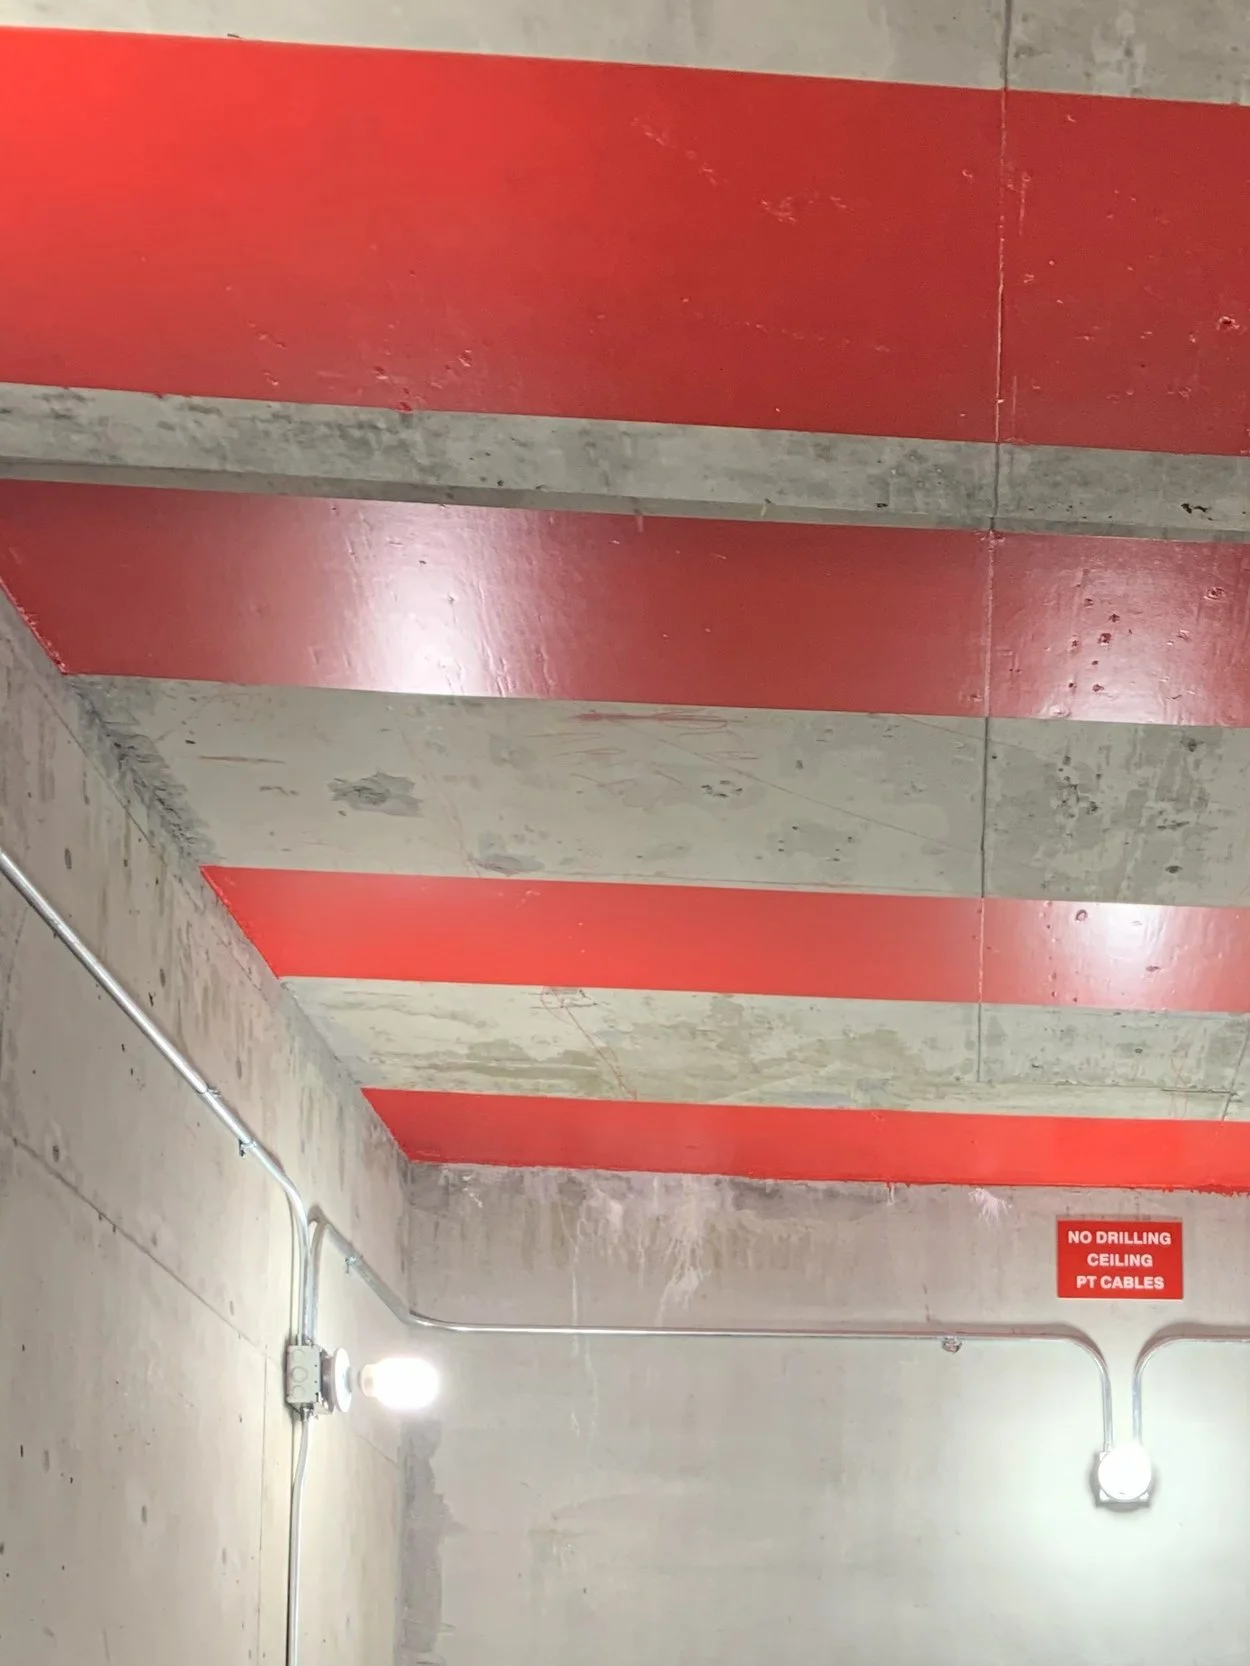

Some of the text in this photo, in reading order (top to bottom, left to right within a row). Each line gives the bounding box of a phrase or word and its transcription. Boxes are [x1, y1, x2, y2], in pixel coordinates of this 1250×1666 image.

[1068, 1231, 1171, 1245] NO DRILLING
[1087, 1253, 1153, 1267] CEILING
[1076, 1276, 1165, 1290] PT CABLES
